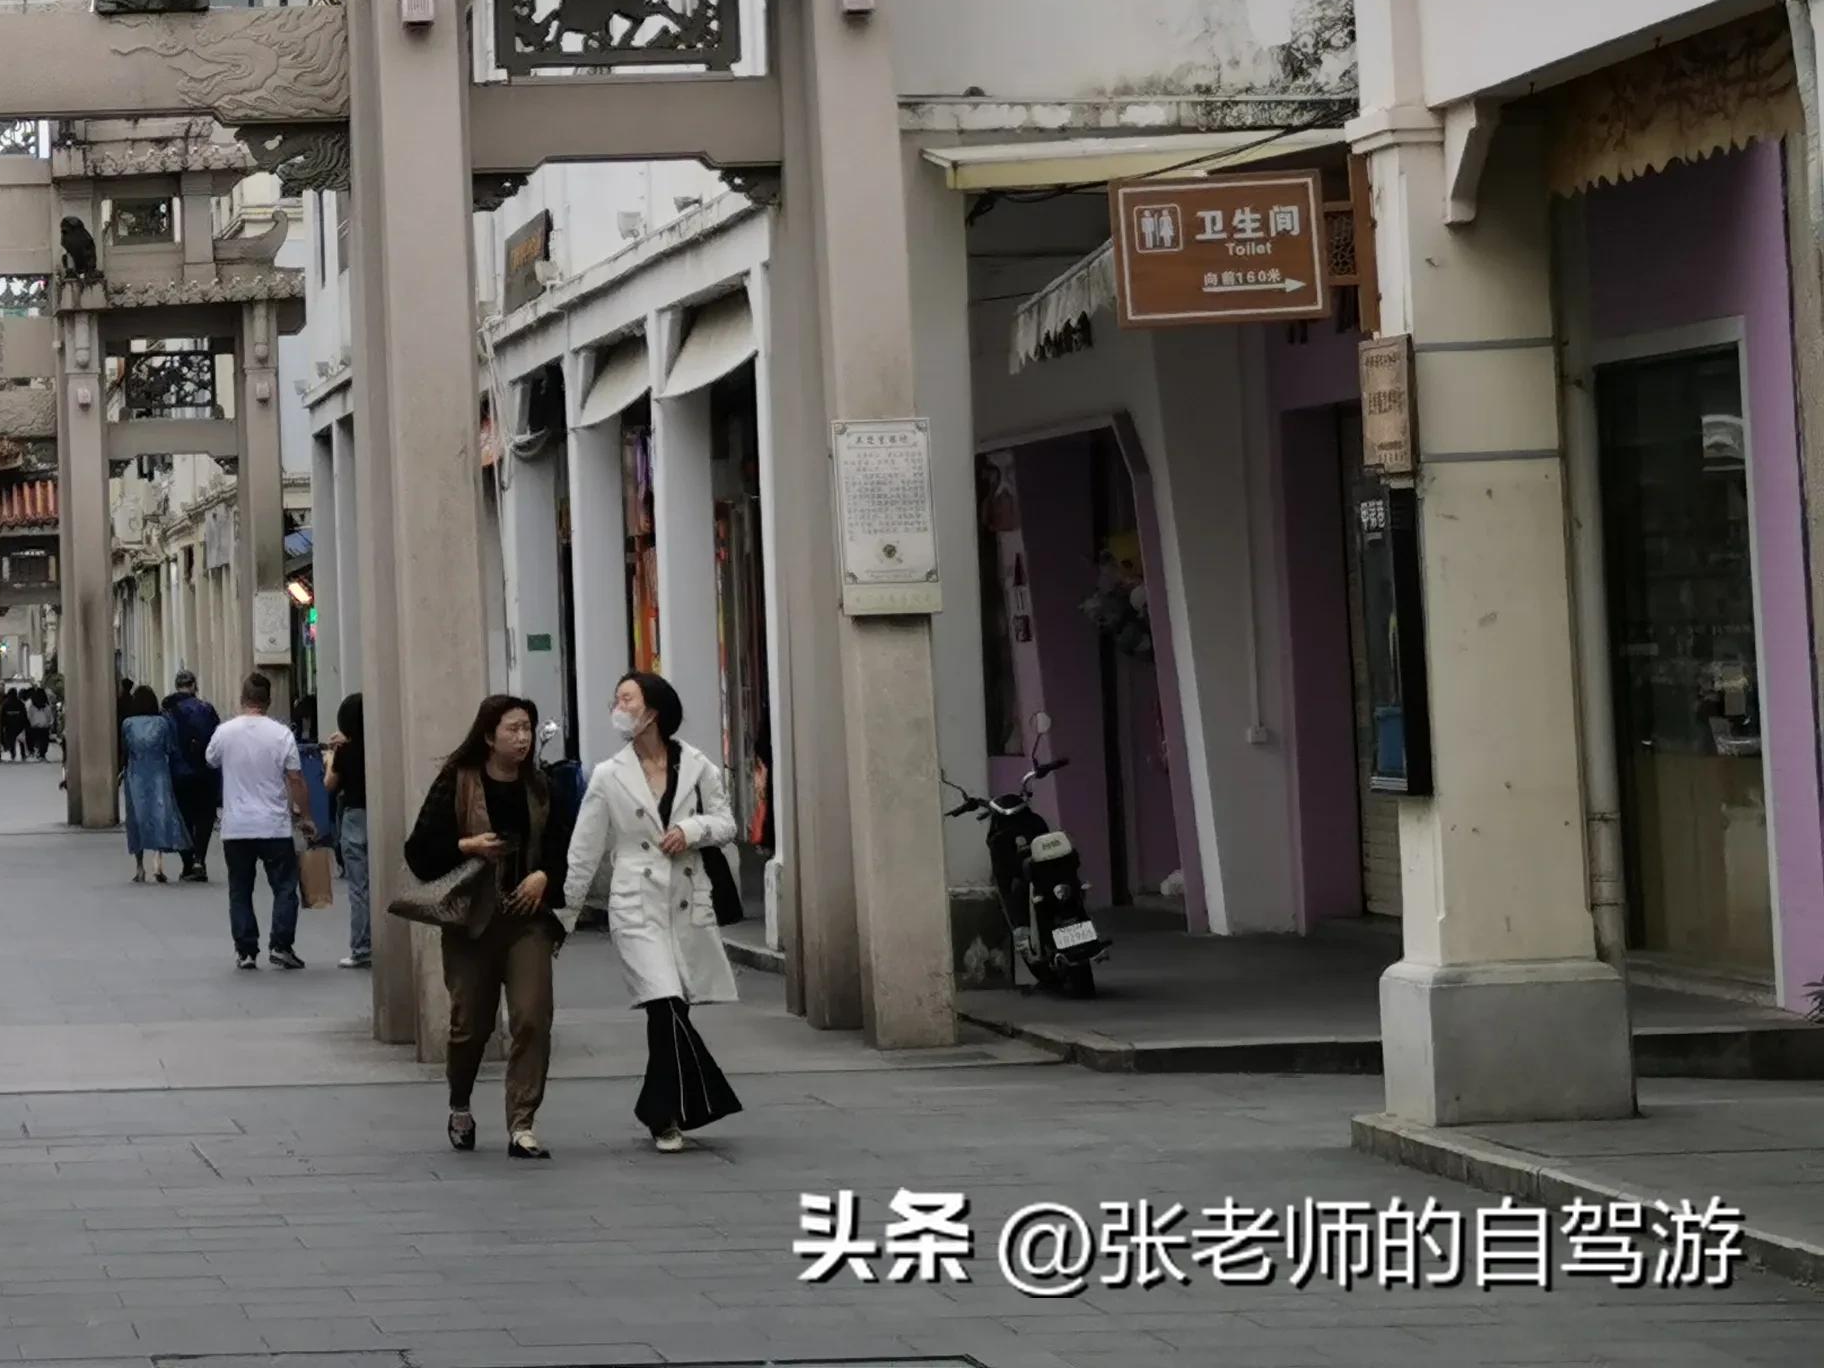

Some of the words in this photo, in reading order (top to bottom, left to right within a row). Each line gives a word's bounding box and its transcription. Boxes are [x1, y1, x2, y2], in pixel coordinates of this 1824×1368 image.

[1194, 204, 1301, 241] 卫生间
[1224, 242, 1273, 257] Toilet
[1203, 268, 1282, 287] 向前160米
